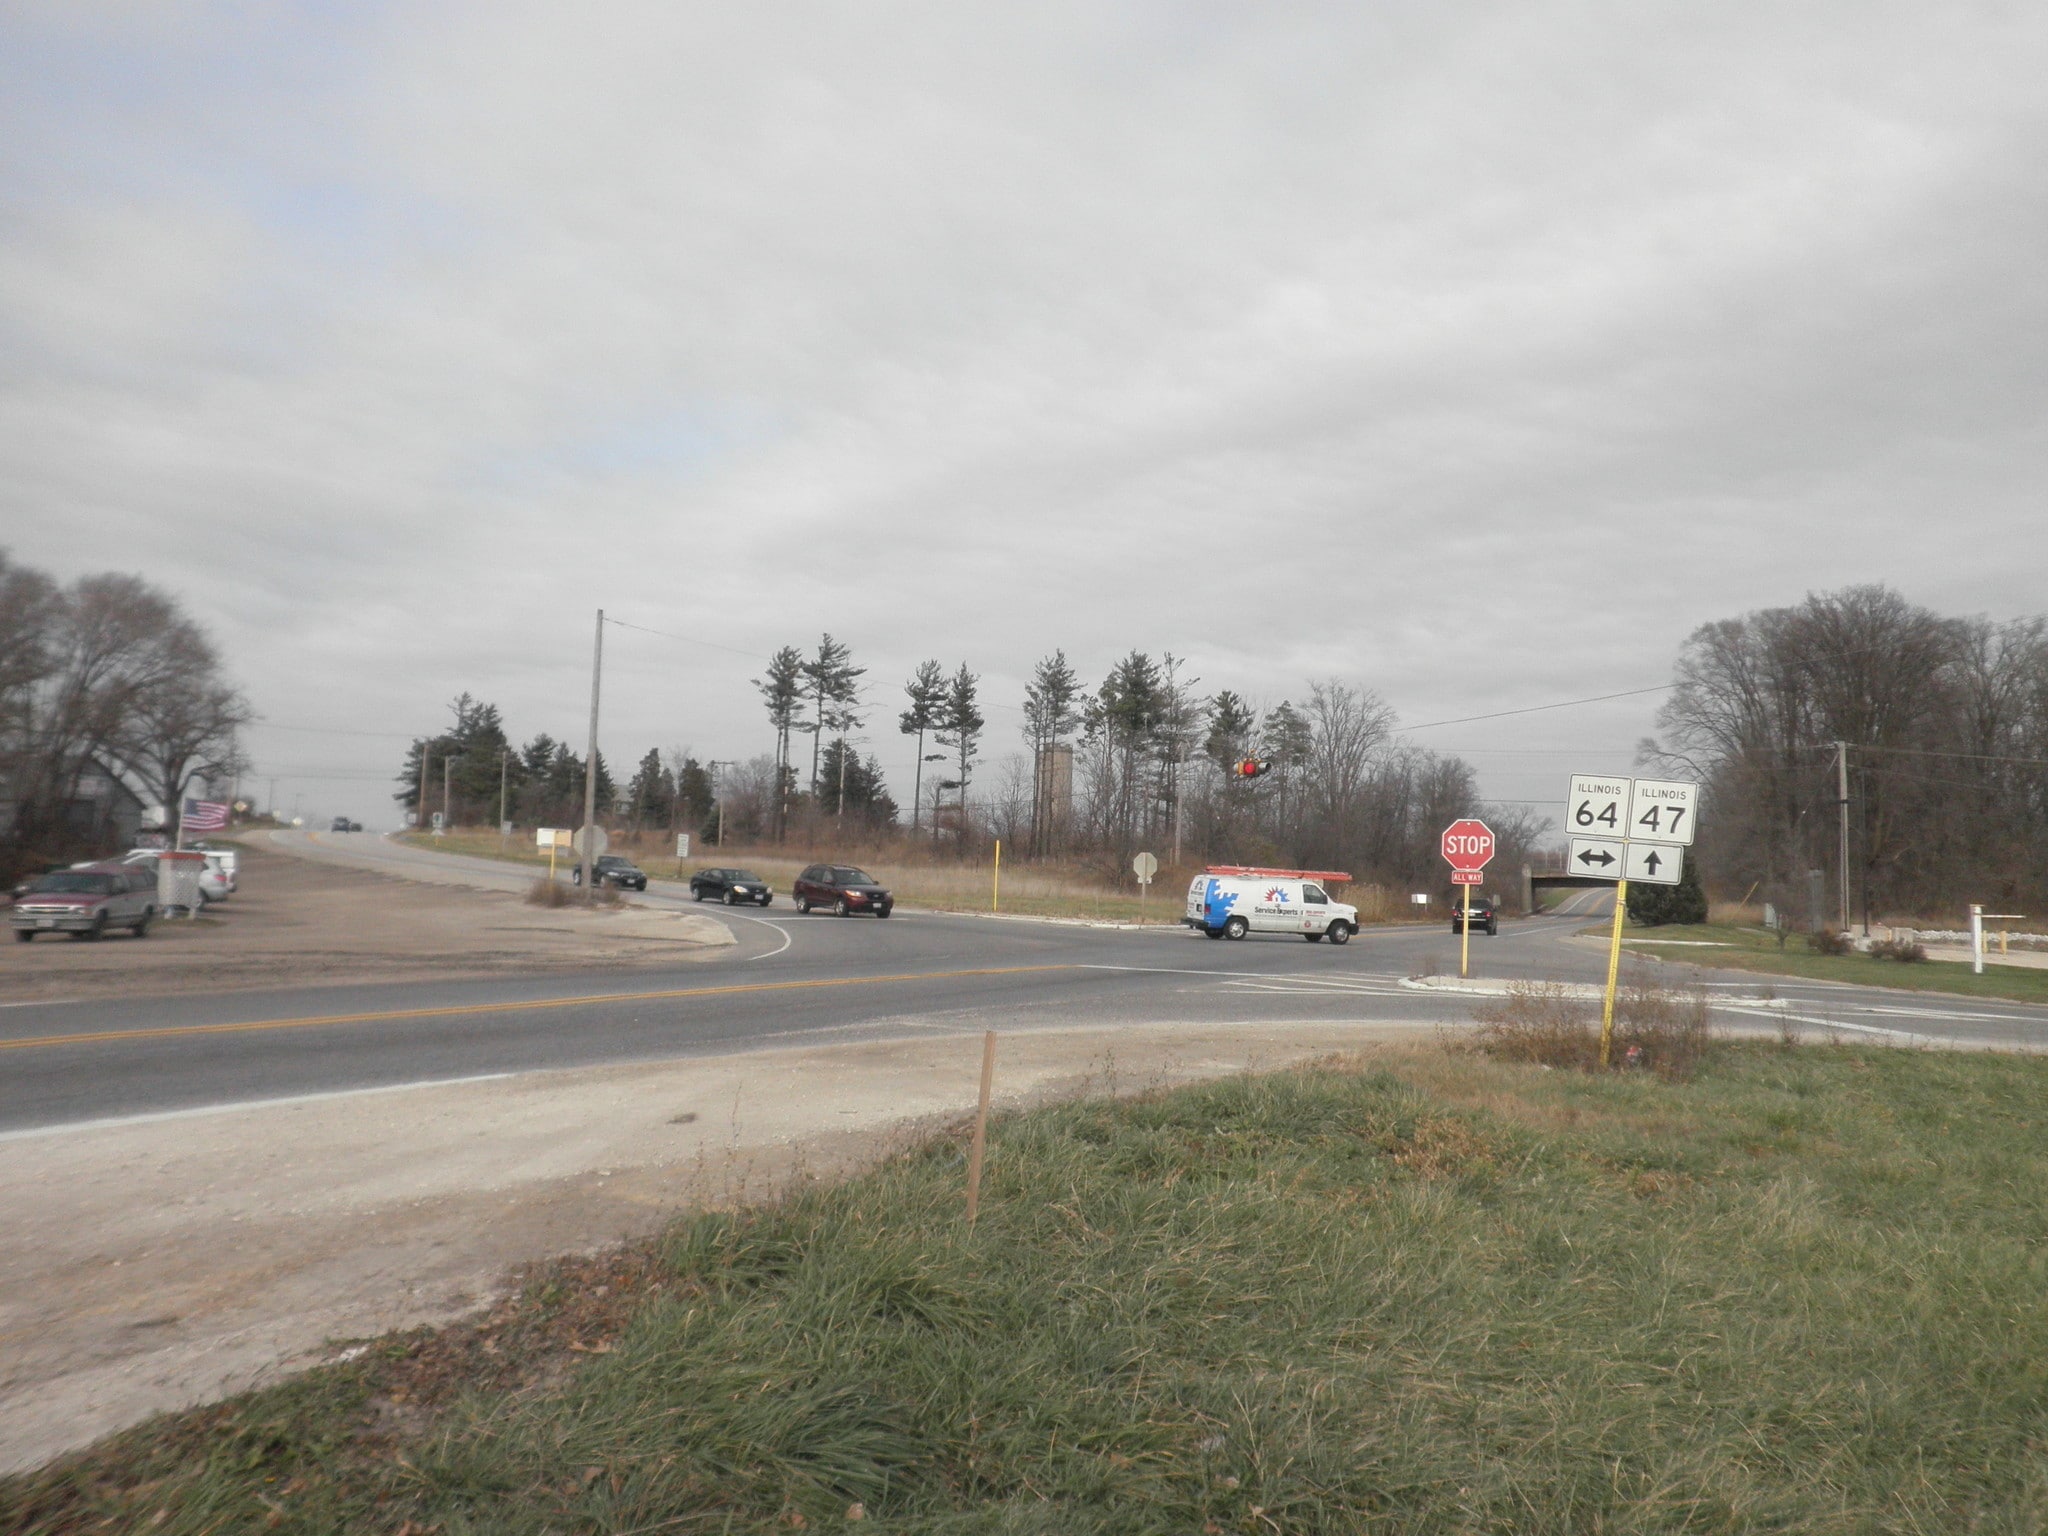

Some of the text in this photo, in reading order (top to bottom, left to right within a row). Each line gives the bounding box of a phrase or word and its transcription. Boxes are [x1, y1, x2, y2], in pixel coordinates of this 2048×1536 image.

[1578, 783, 1622, 795] ILLINOIS
[1641, 788, 1687, 800] ILLINOIS
[1575, 799, 1618, 829] 64
[1638, 805, 1686, 834] 47
[1446, 835, 1491, 854] STOP
[1453, 873, 1482, 881] ALL WAY
[1254, 906, 1276, 914] Service
